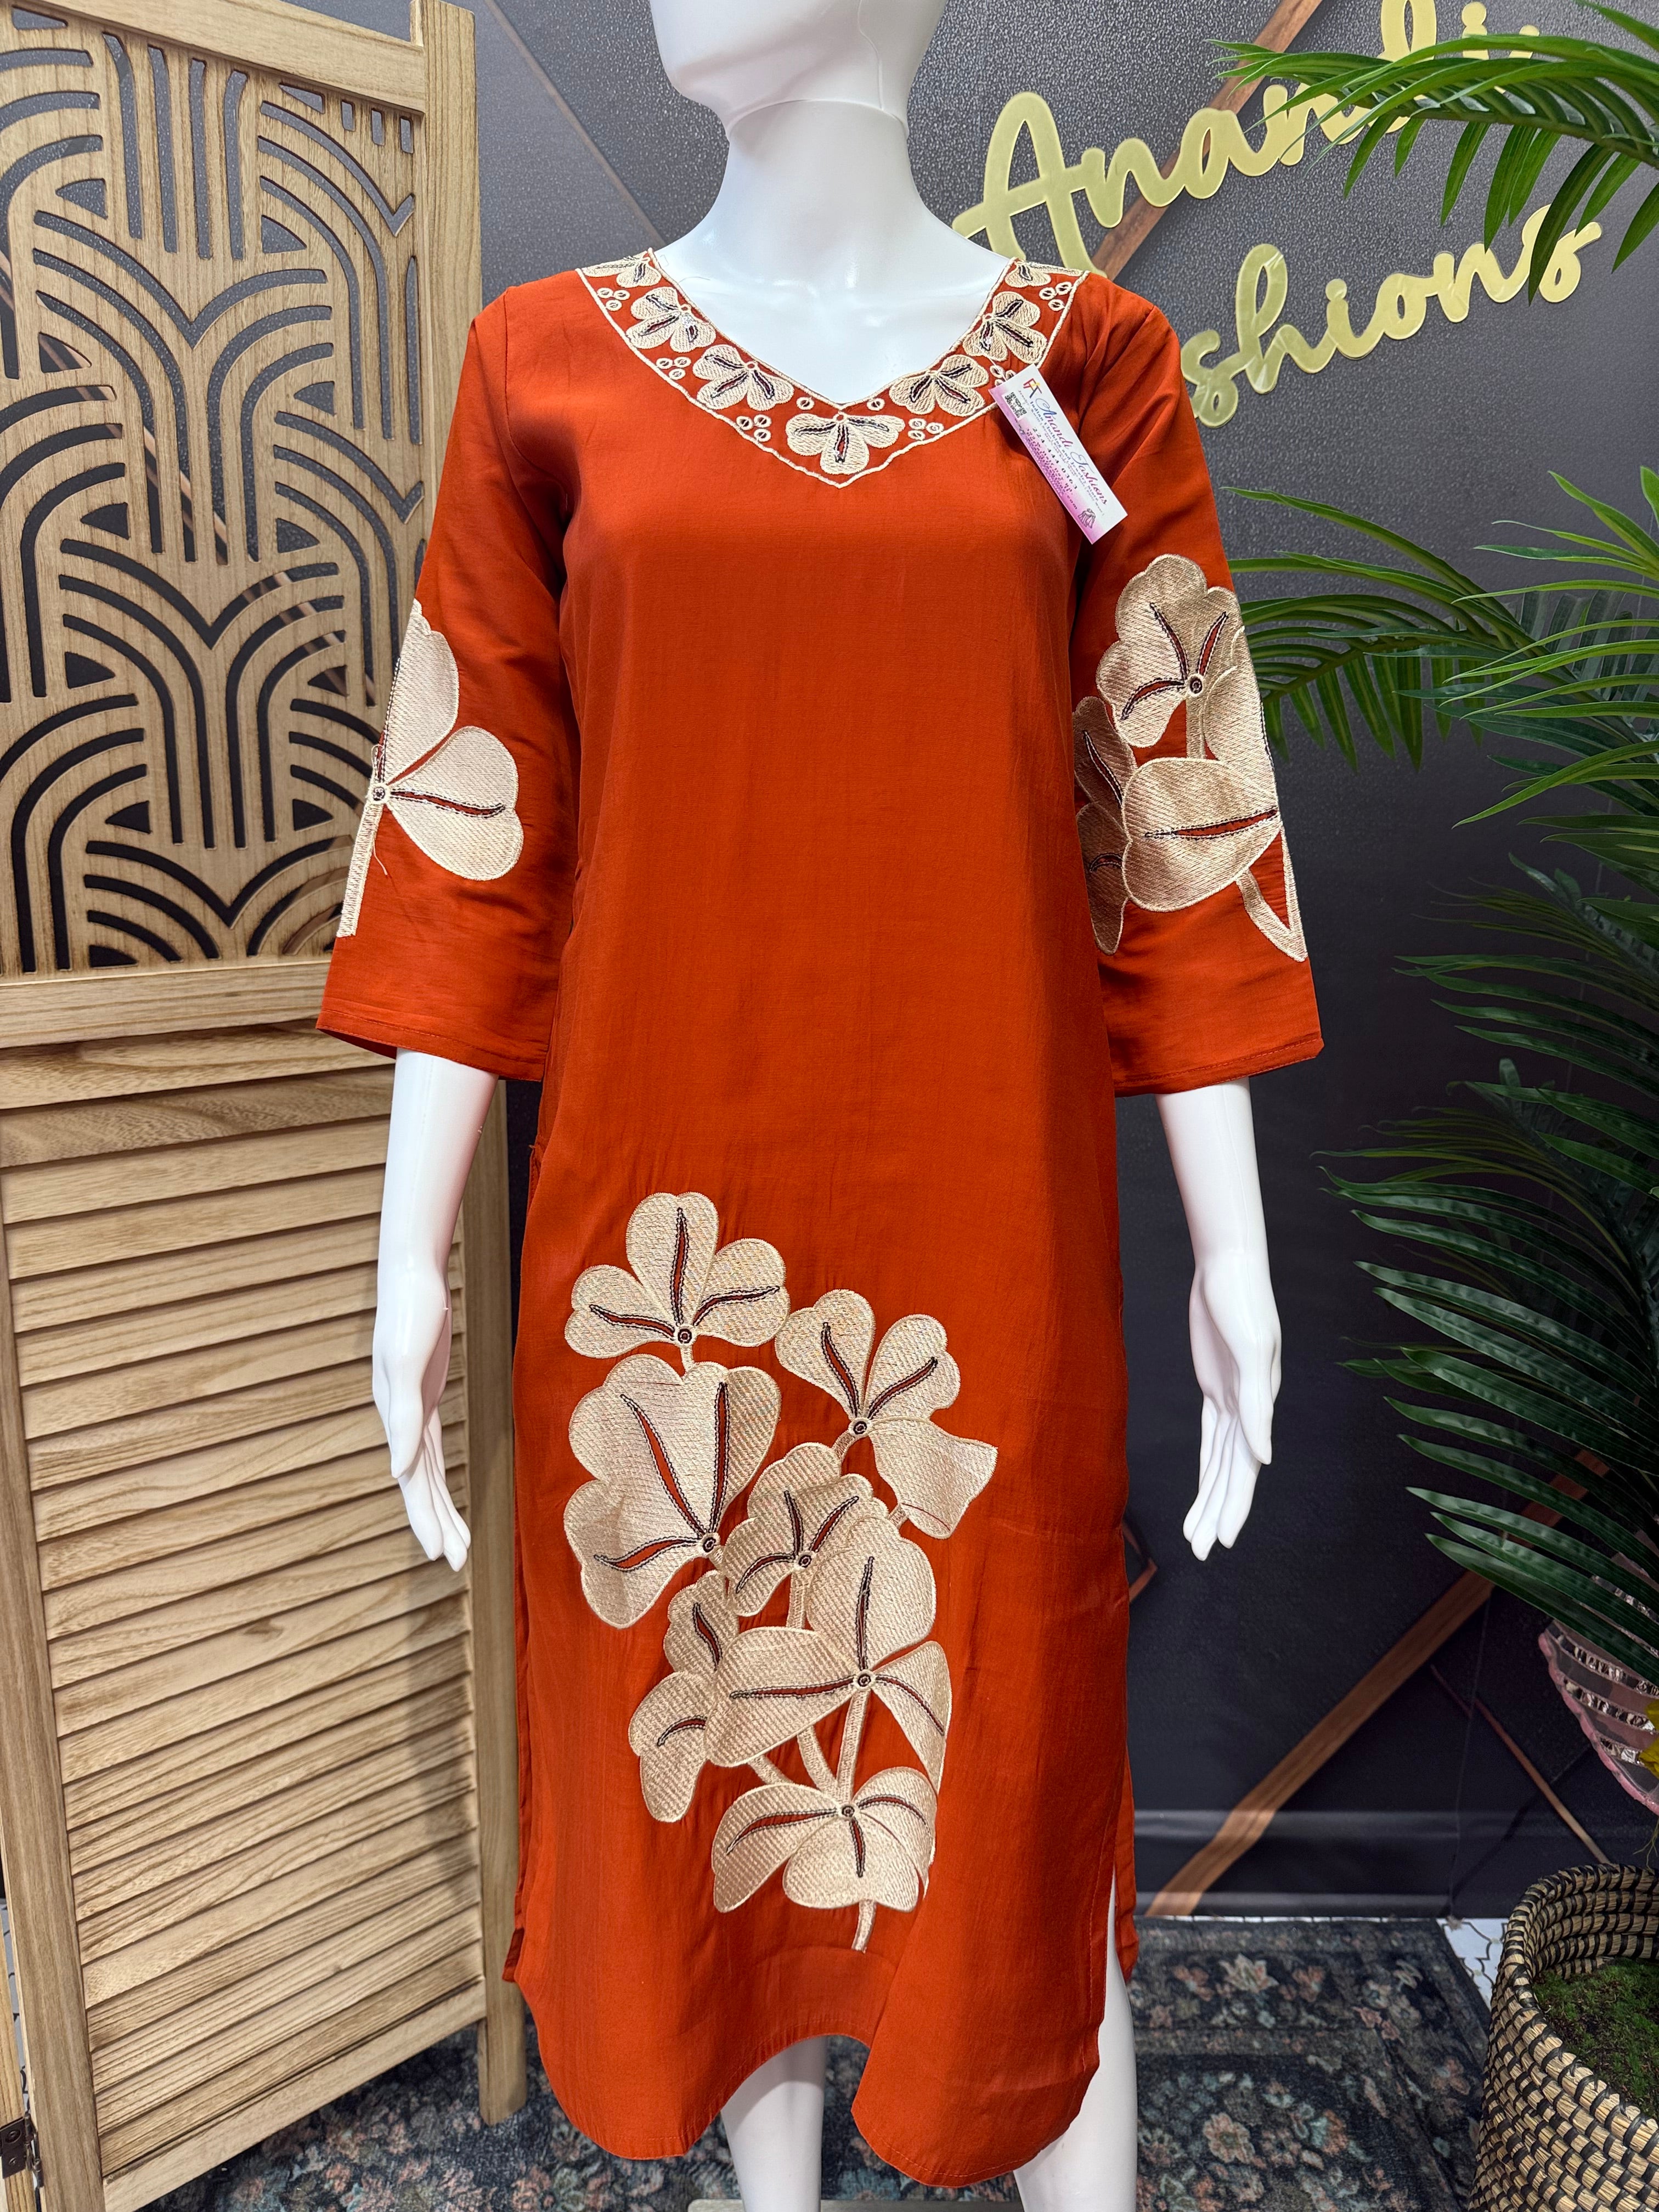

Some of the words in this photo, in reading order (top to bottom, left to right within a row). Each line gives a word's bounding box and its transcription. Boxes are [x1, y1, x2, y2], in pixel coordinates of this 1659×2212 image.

[1181, 205, 1602, 427] shions
[1030, 401, 1045, 421] Indian
[1062, 448, 1071, 460] and
[1035, 398, 1073, 450] Anandi
[1070, 452, 1107, 505] Fashions
